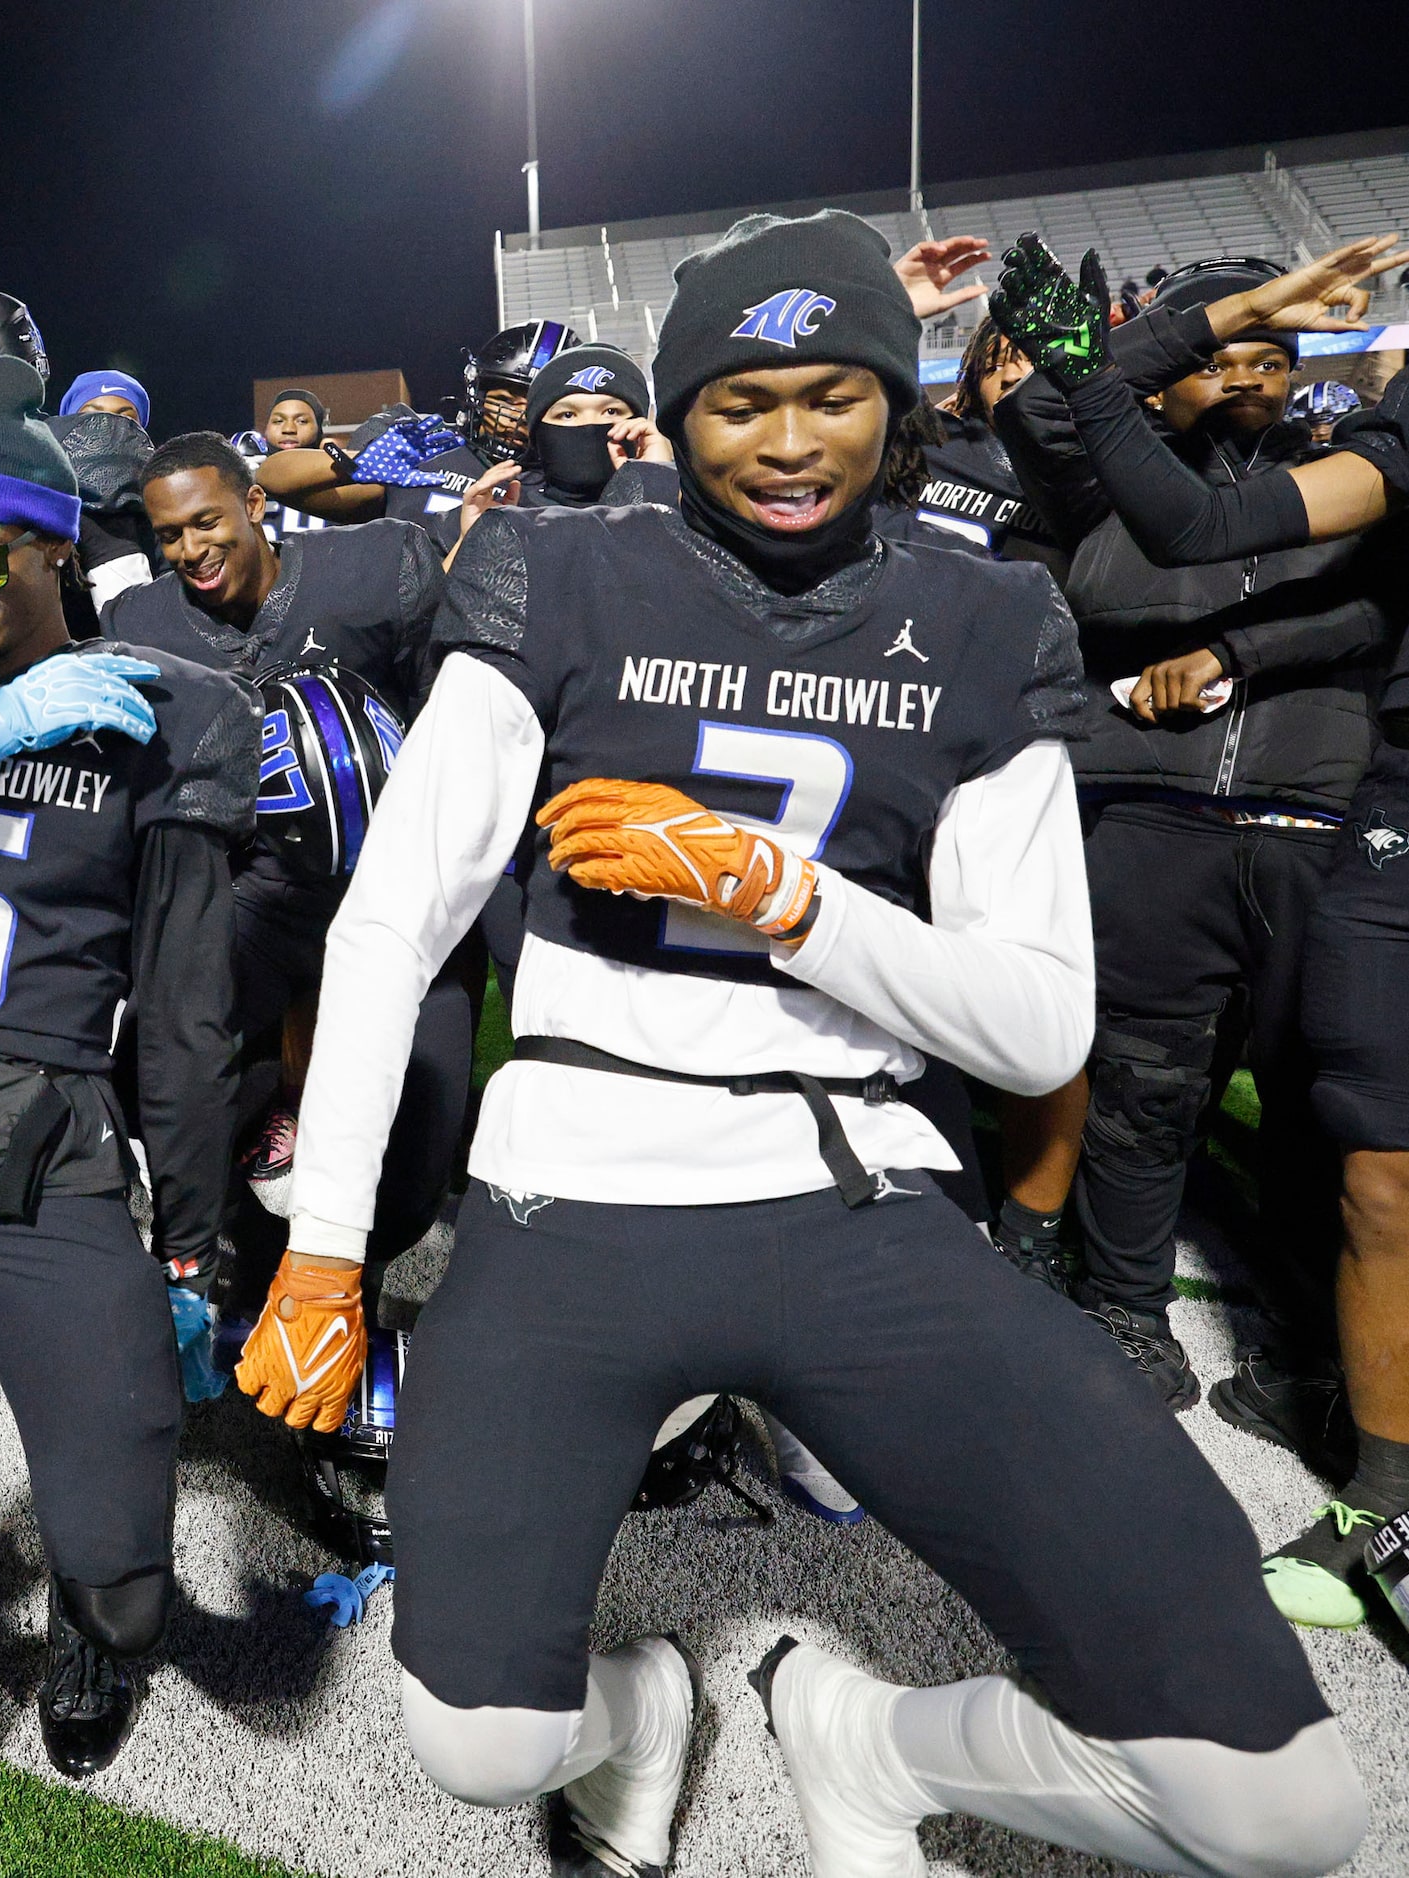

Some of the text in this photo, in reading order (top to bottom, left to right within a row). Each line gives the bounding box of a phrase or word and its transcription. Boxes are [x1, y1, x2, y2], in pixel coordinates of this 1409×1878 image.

[730, 288, 837, 348] NC
[918, 479, 993, 518] NORTH
[618, 656, 943, 733] NORTH CROWLEY
[1368, 1524, 1402, 1565] CITY
